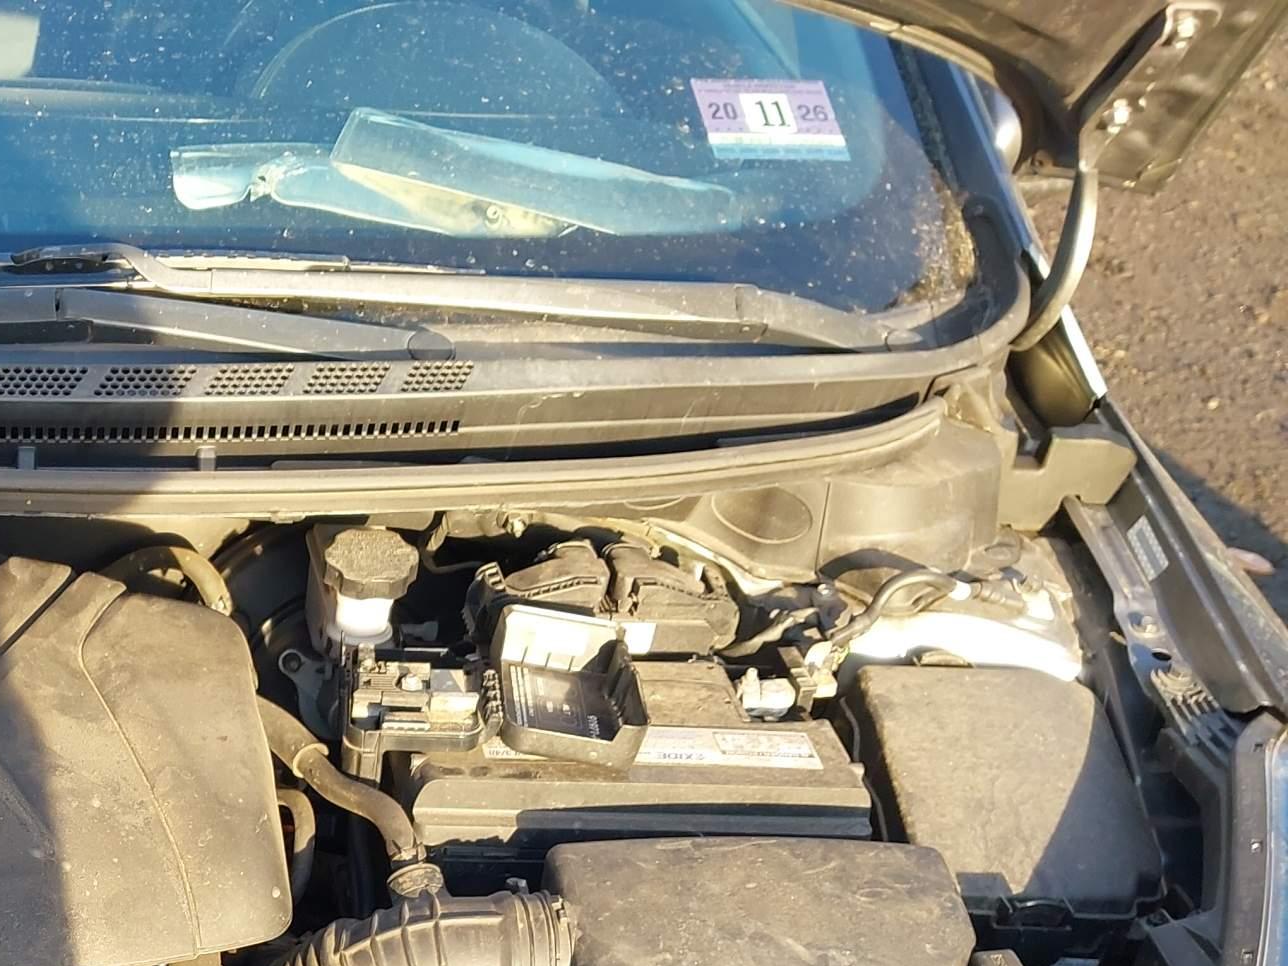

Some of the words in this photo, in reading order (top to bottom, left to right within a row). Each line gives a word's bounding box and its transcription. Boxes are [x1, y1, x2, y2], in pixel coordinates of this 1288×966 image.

[708, 102, 738, 120] 20
[755, 100, 788, 127] 11
[797, 104, 828, 122] 26
